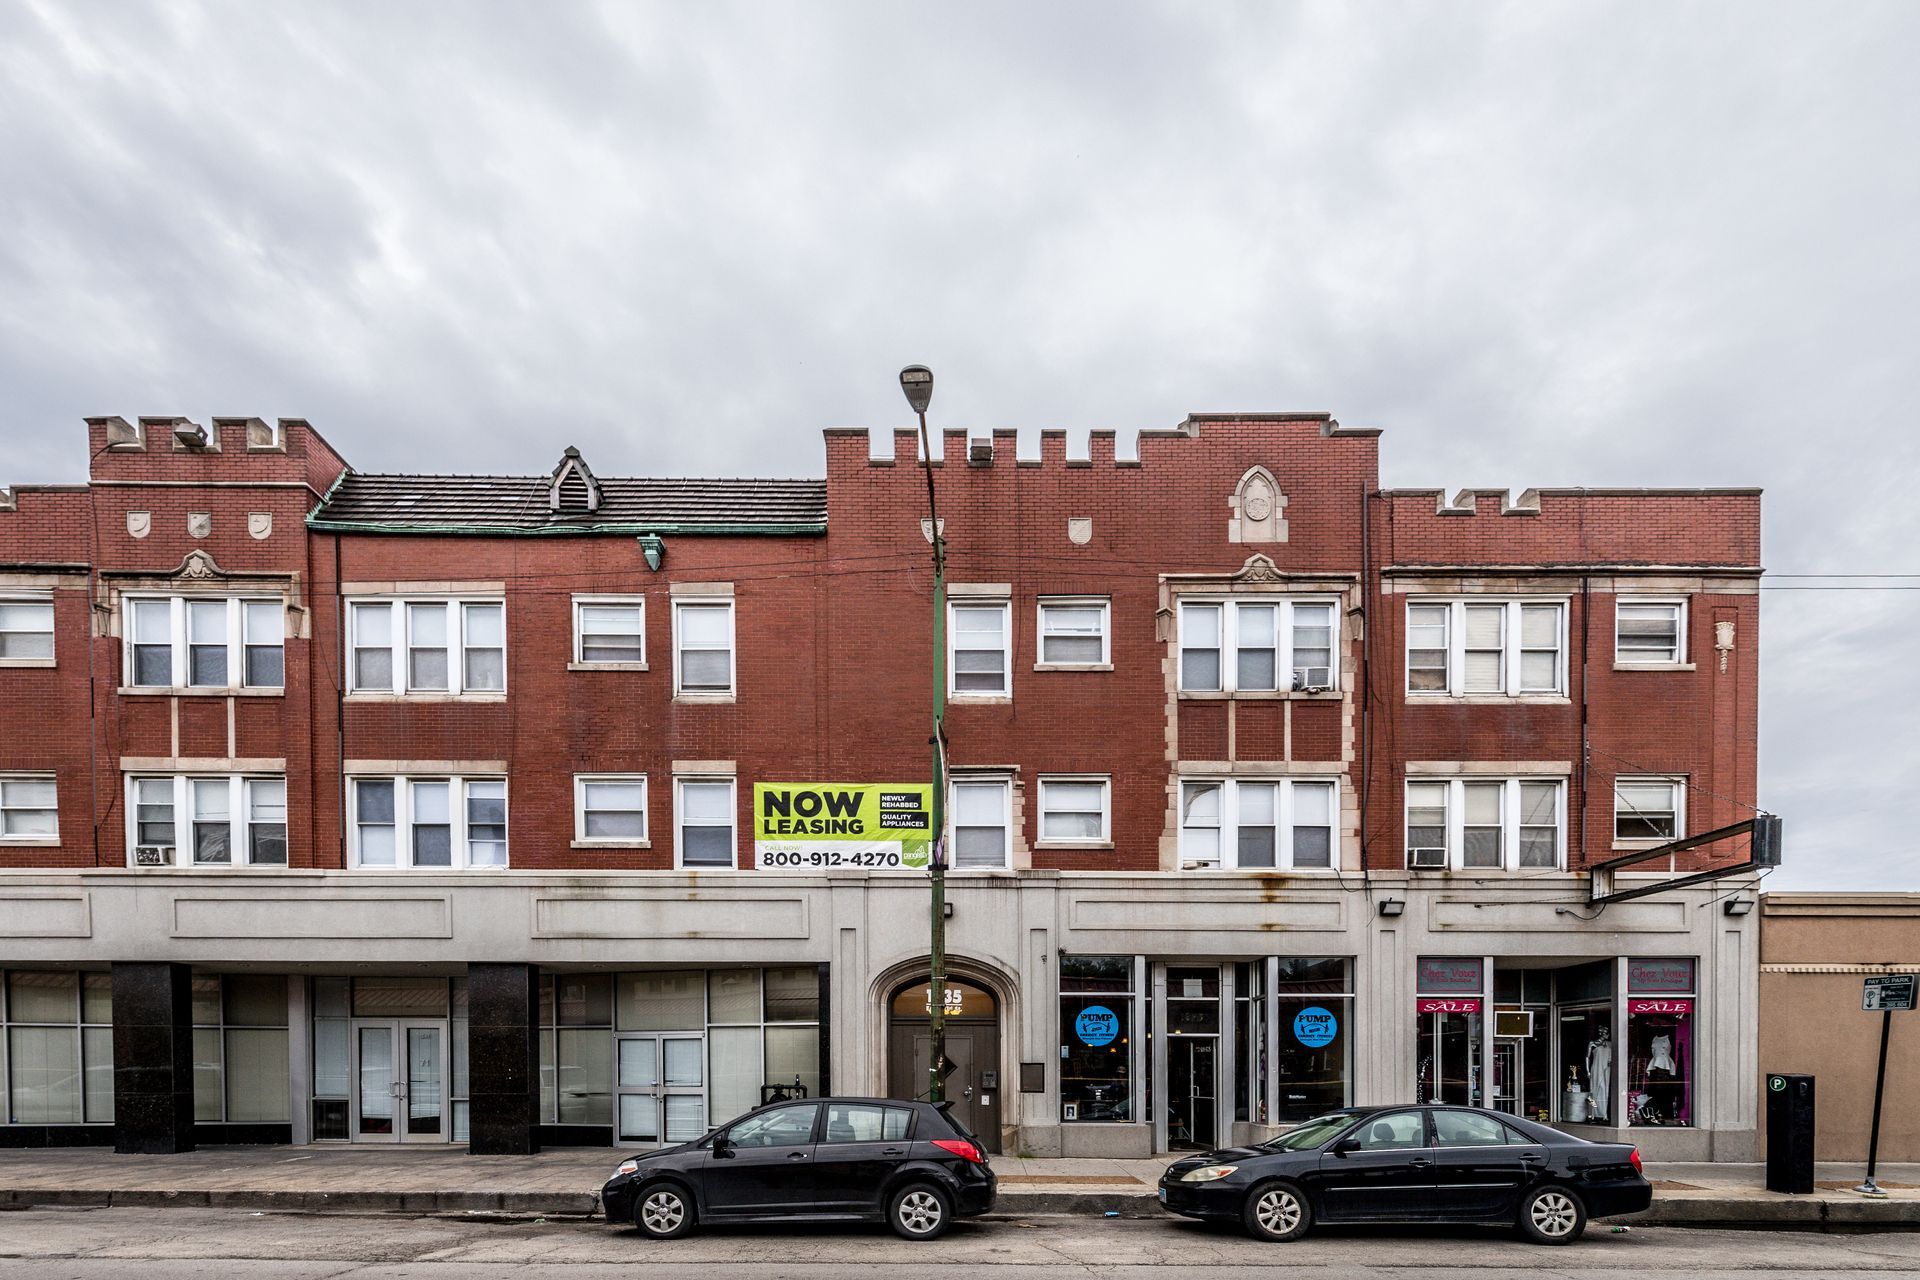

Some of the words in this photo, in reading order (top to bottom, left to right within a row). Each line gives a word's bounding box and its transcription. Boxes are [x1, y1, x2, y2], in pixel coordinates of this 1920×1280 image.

[764, 791, 864, 817] NOW
[763, 819, 864, 835] LEASING
[763, 852, 899, 867] 800-912-4270
[1631, 967, 1656, 978] Chez
[926, 989, 962, 1004] 135
[1423, 1003, 1475, 1012] SALE
[1634, 1003, 1687, 1012] SALE
[1081, 1013, 1113, 1021] PUMP
[1298, 1014, 1331, 1022] PUMP
